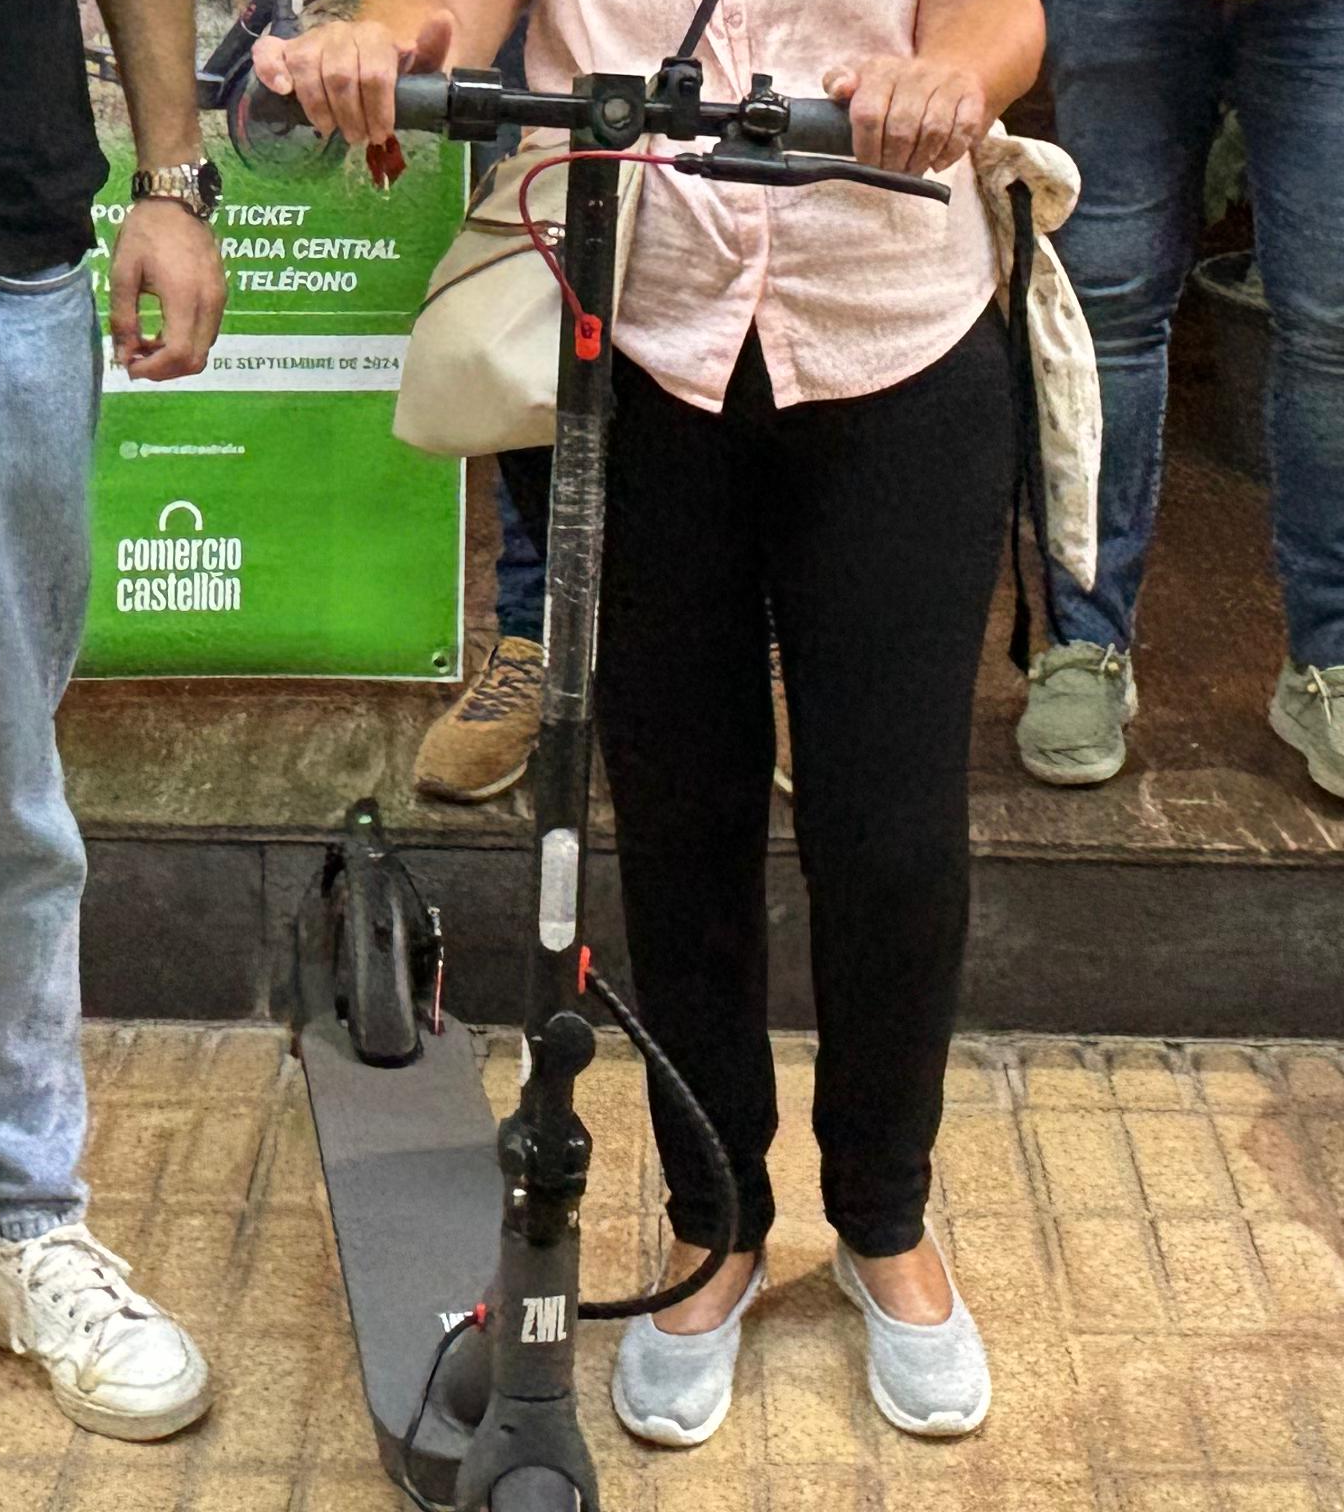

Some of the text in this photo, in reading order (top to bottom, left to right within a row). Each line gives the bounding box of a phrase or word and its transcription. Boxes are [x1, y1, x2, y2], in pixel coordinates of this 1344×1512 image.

[224, 205, 311, 226] TICKET
[292, 238, 401, 260] CENTRAL
[238, 266, 358, 292] TELÉFONO
[236, 356, 335, 371] SEPTIEMBRE
[117, 537, 242, 572] comercio
